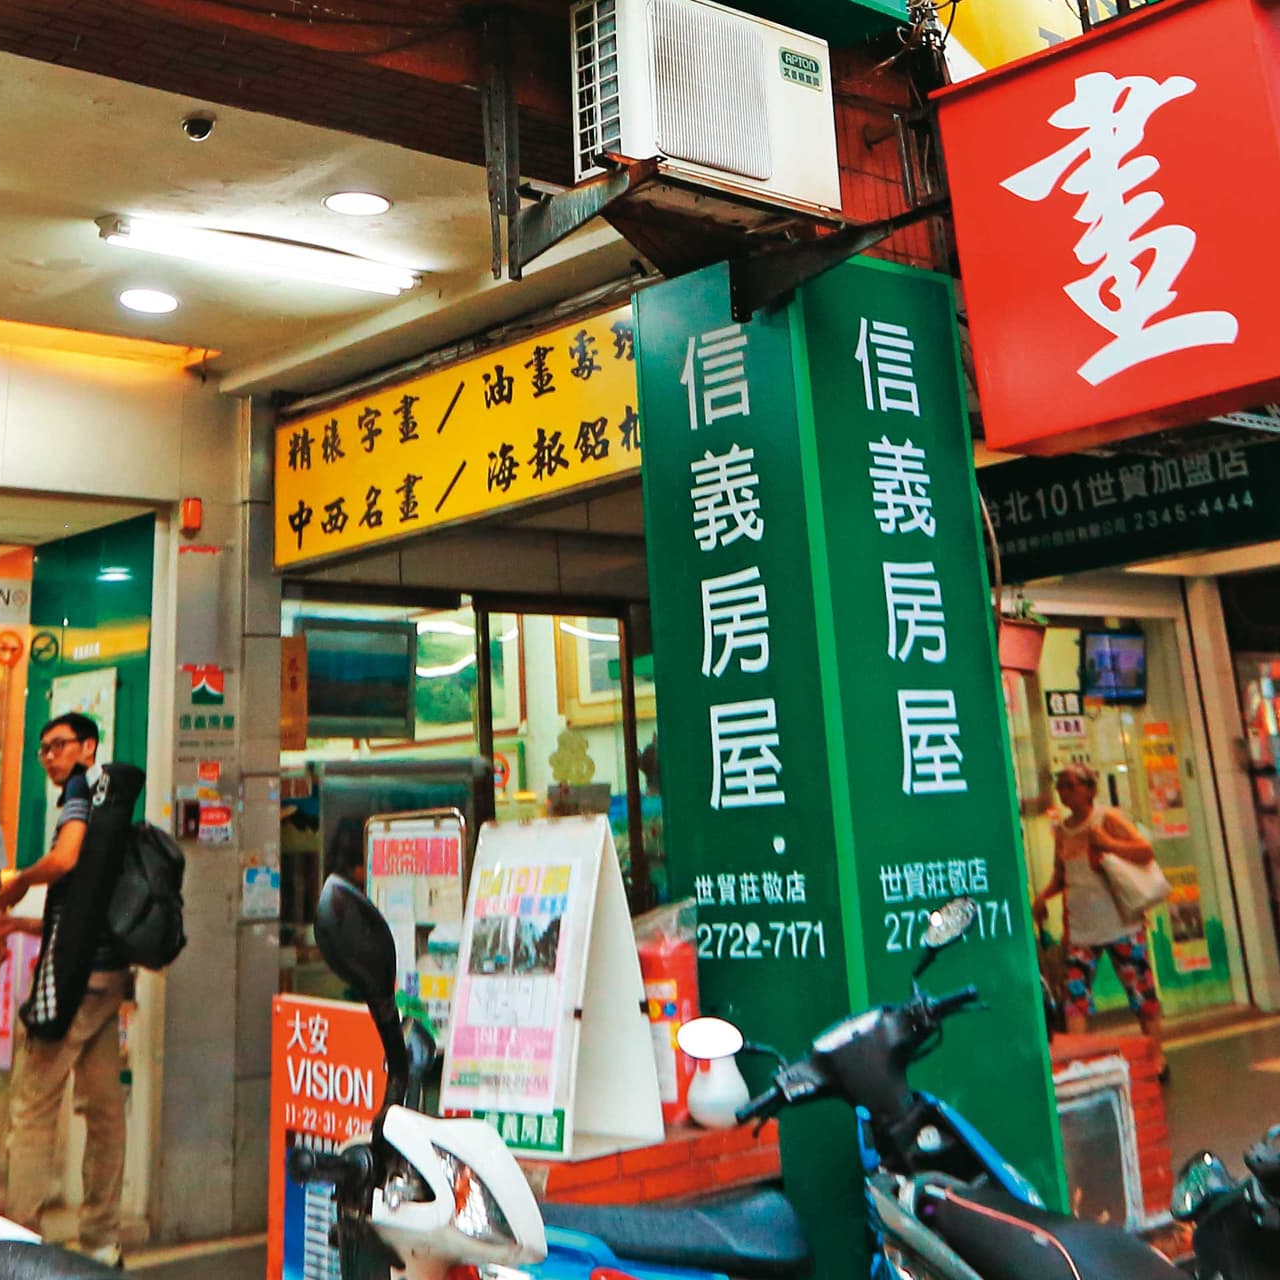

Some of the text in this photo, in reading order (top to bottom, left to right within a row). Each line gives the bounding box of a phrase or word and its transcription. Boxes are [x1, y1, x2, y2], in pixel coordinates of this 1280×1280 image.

[999, 71, 1240, 387] 畫
[678, 322, 787, 810] 信義房屋
[853, 316, 968, 796] 信義房屋
[694, 870, 807, 906] 世貿莊敬店
[879, 856, 990, 904] 世貿莊敬店
[696, 919, 827, 960] 2722-7171
[286, 1009, 329, 1057] 大安
[286, 1055, 374, 1111] VISION
